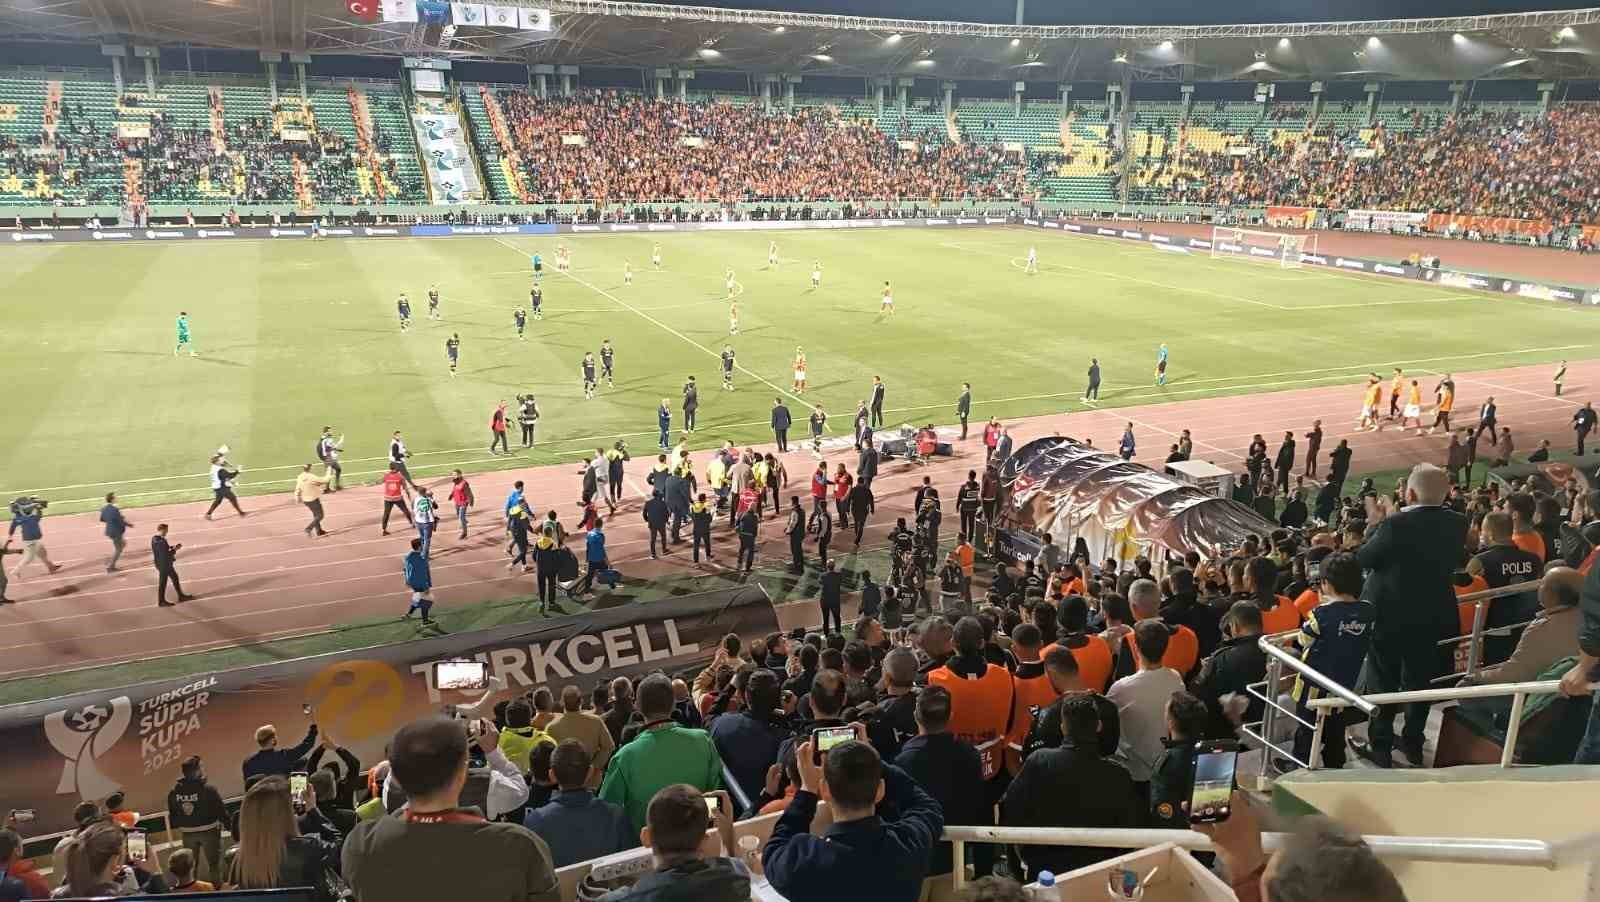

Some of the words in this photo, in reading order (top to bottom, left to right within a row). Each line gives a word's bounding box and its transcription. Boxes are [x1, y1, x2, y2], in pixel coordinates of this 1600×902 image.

[139, 676, 219, 713] TURKCELL
[139, 691, 210, 736] SÜPER
[141, 713, 201, 759] KUPA
[143, 744, 182, 776] 2023
